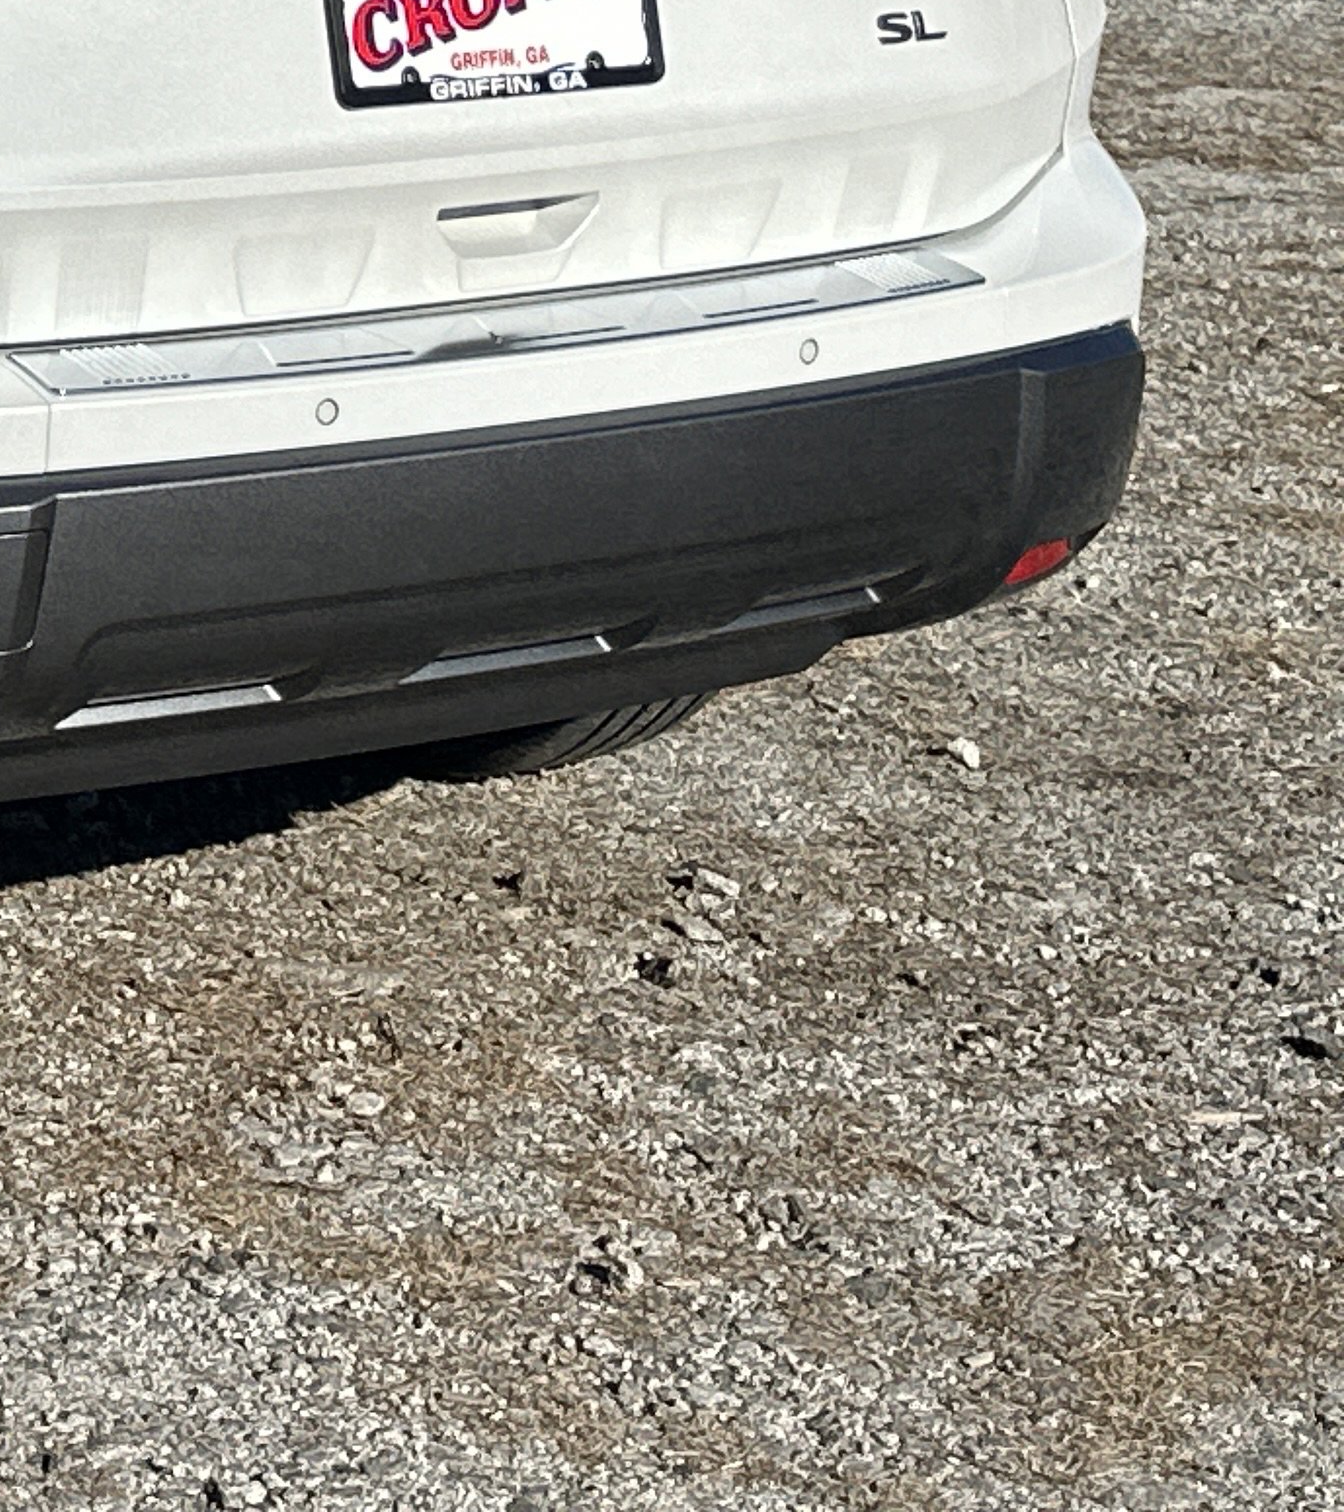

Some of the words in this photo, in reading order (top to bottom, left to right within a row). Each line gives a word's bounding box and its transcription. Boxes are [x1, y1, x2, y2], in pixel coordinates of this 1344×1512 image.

[877, 10, 948, 45] SL
[451, 49, 521, 71] GRIFFIN,
[526, 45, 550, 65] GA
[430, 75, 540, 100] GRIFFIN,
[549, 71, 587, 90] GA
